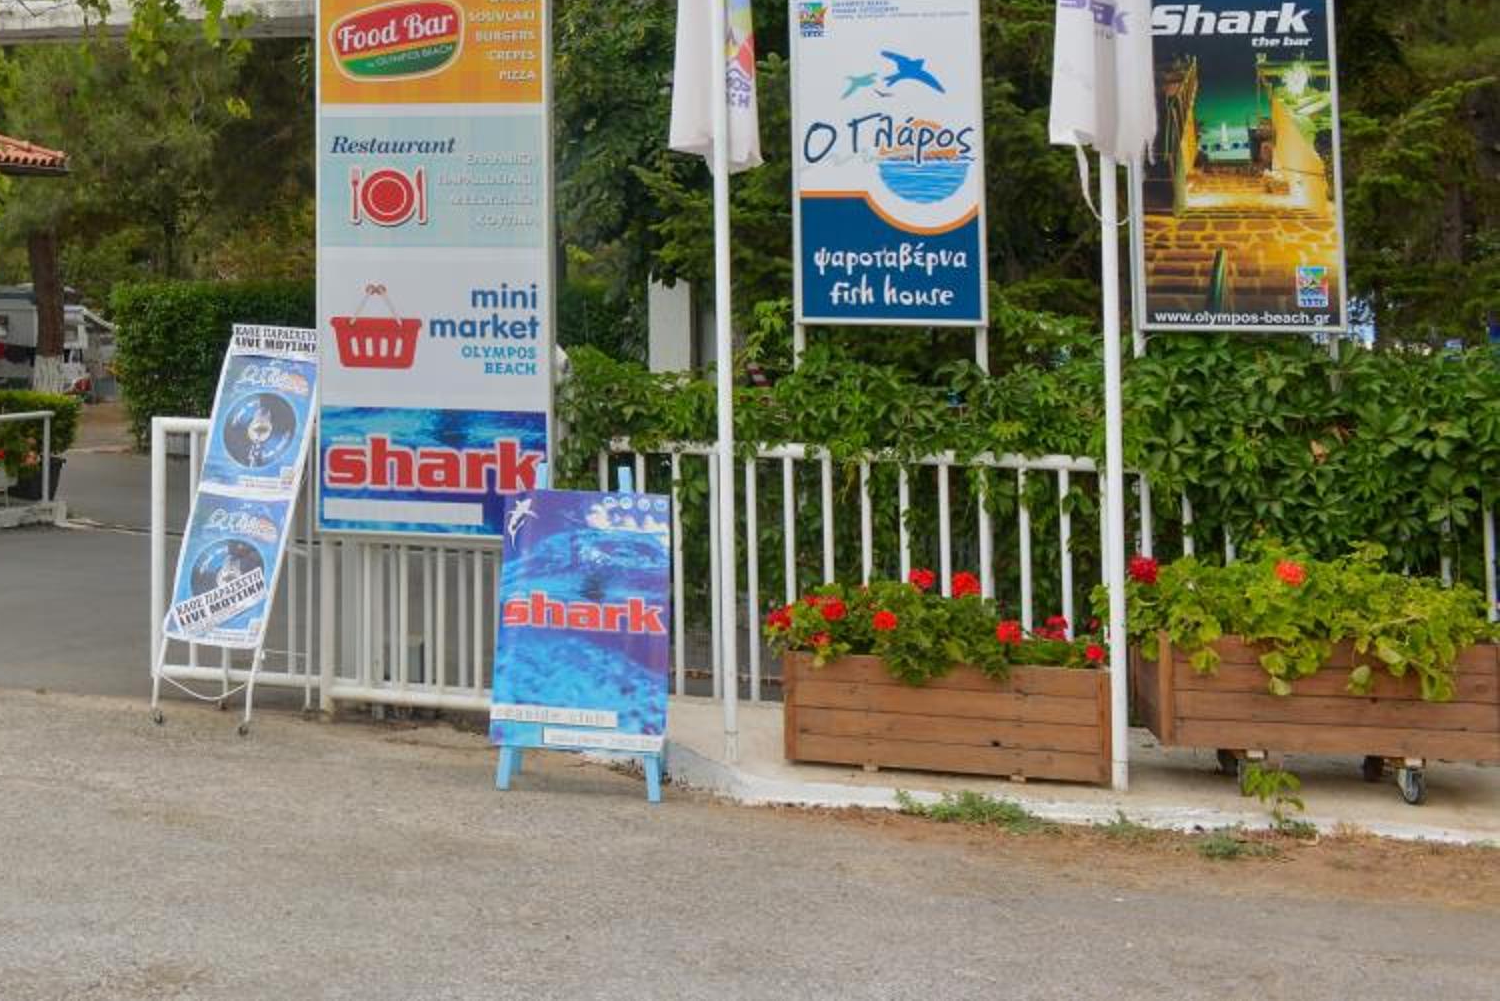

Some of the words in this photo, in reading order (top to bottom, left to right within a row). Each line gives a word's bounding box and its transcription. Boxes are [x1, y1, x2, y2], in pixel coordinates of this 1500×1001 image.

[337, 25, 397, 51] Food
[402, 11, 454, 40] Bar
[1150, 2, 1312, 35] Shark
[1251, 34, 1280, 47] the
[1283, 34, 1312, 47] bar
[331, 135, 456, 155] Restaurant
[813, 243, 968, 276] ψαροταβέρνα
[471, 283, 538, 309] mini
[829, 273, 875, 307] fish
[883, 274, 955, 306] house
[429, 314, 539, 341] market
[1154, 309, 1331, 325] www.olympos-beach.gr
[461, 346, 537, 360] OLYMPOS
[484, 361, 537, 376] BEACH
[325, 435, 544, 495] shark
[179, 608, 207, 626] LIVE
[503, 589, 668, 635] shark
